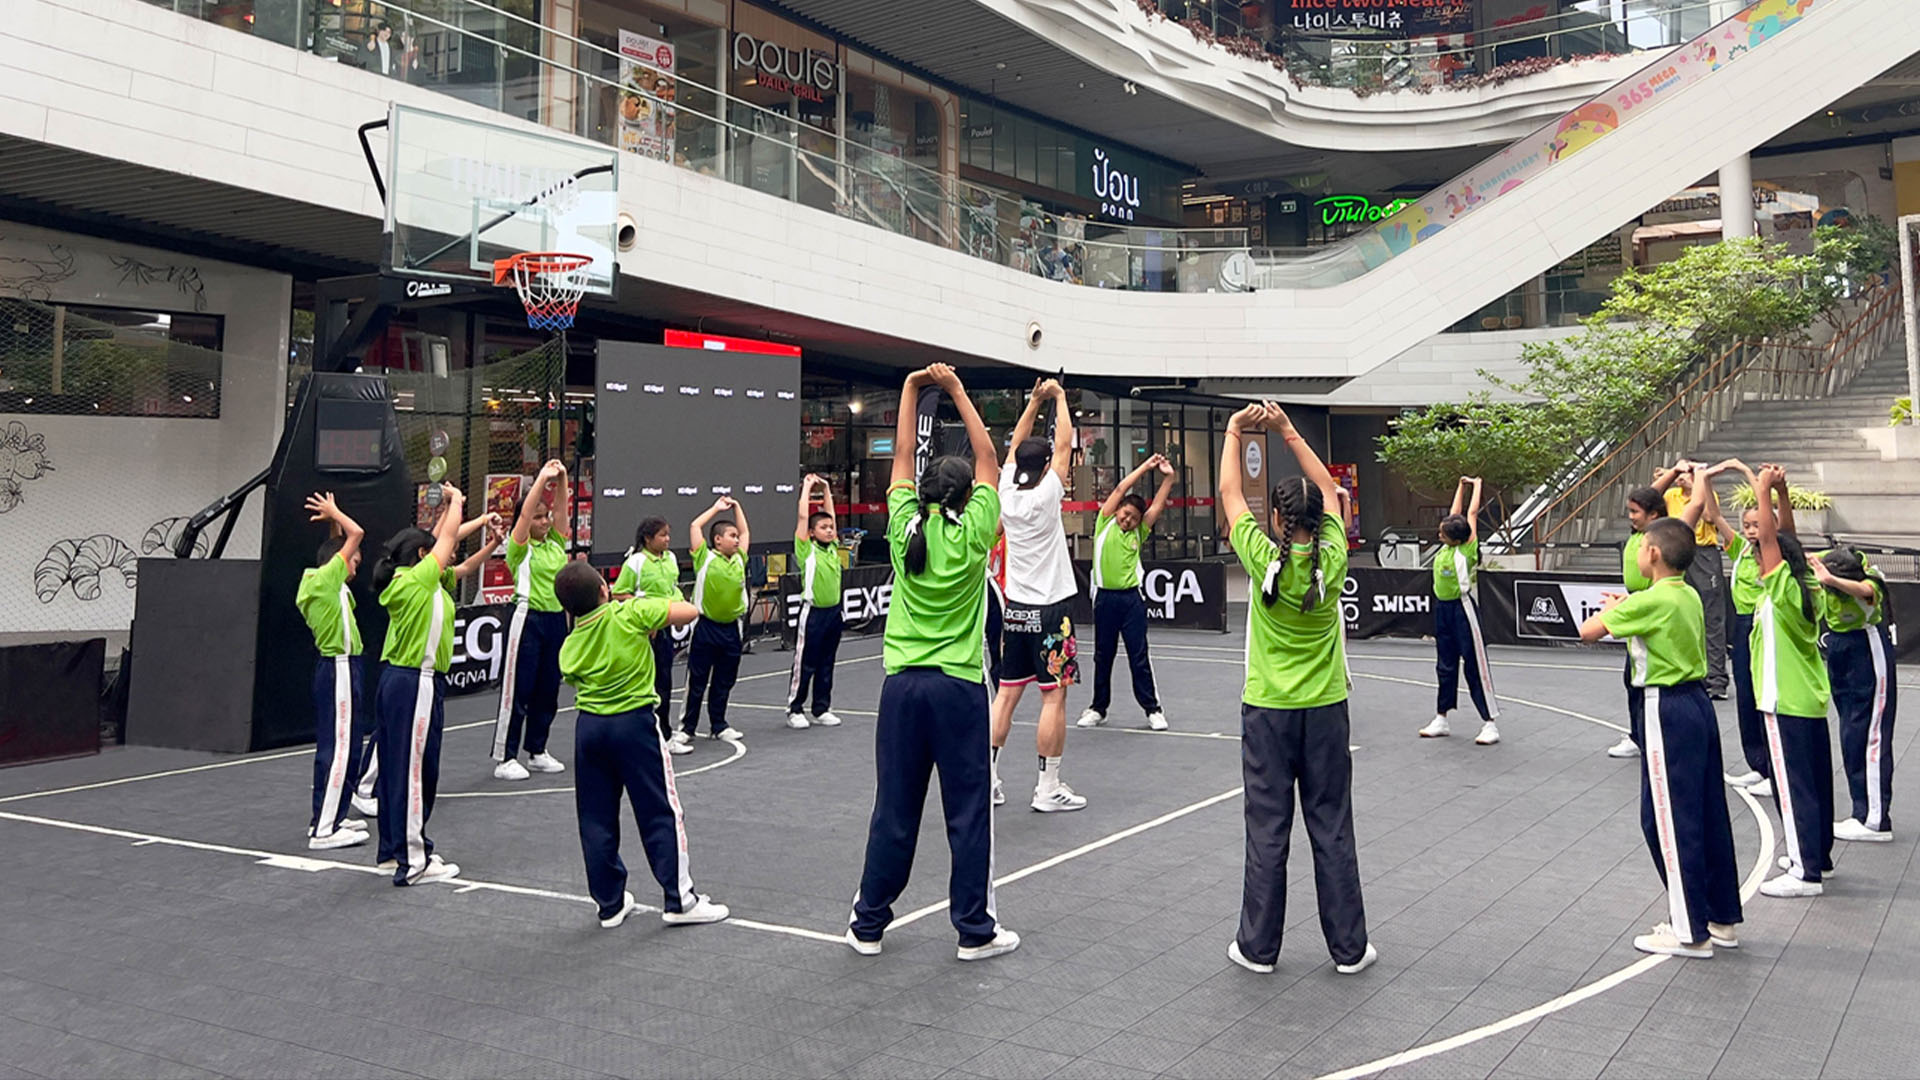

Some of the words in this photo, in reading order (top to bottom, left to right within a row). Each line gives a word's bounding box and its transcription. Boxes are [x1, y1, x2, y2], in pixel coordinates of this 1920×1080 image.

[734, 32, 845, 93] poulet
[757, 72, 791, 93] DAILY
[793, 84, 825, 103] GRILL
[1617, 81, 1654, 110] 365
[1648, 66, 1677, 87] MEGA
[1145, 568, 1204, 619] GA
[1372, 594, 1430, 612] SWISH
